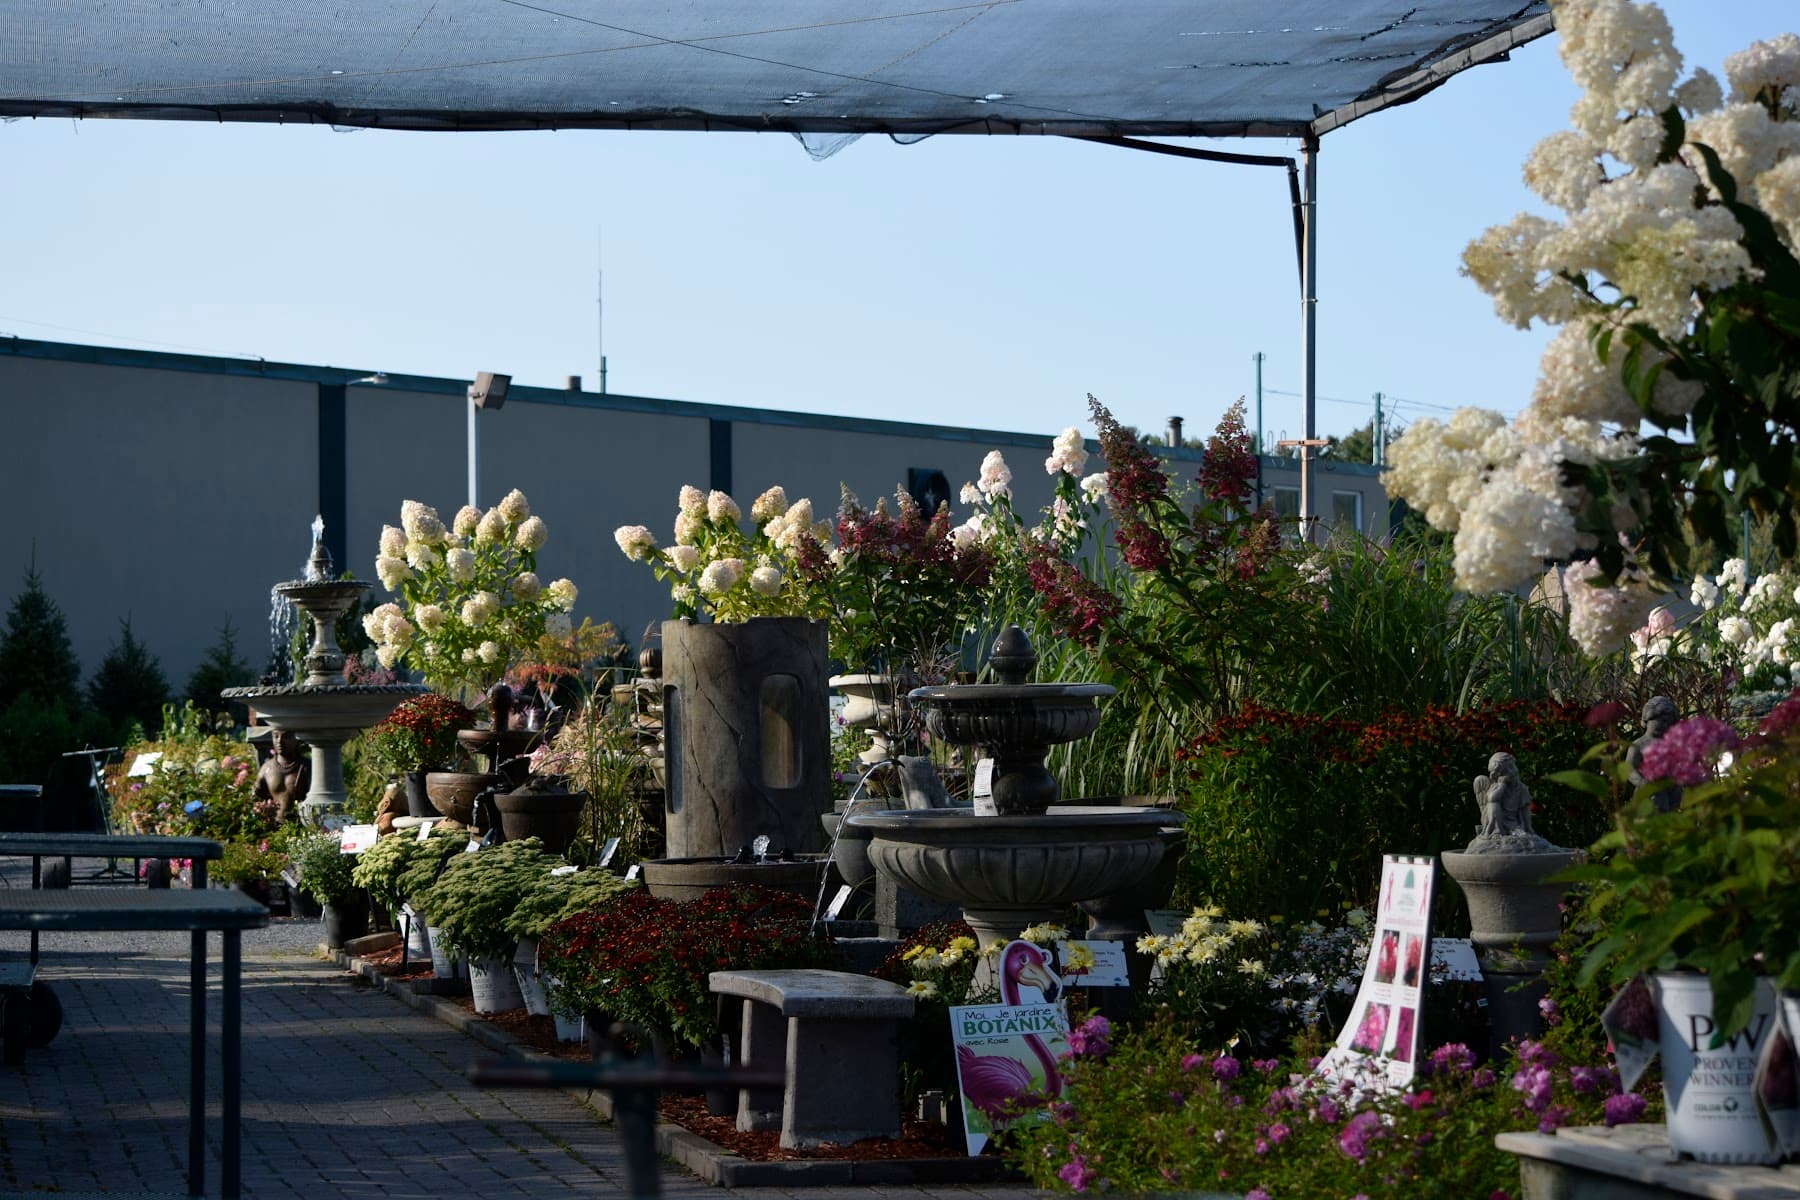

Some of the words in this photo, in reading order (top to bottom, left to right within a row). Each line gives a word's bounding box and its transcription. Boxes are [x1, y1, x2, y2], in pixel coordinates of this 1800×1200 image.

[963, 1016, 1057, 1035] BOTANIX
[1694, 1056, 1759, 1070] PROVEN
[1689, 1072, 1754, 1087] WINNER
